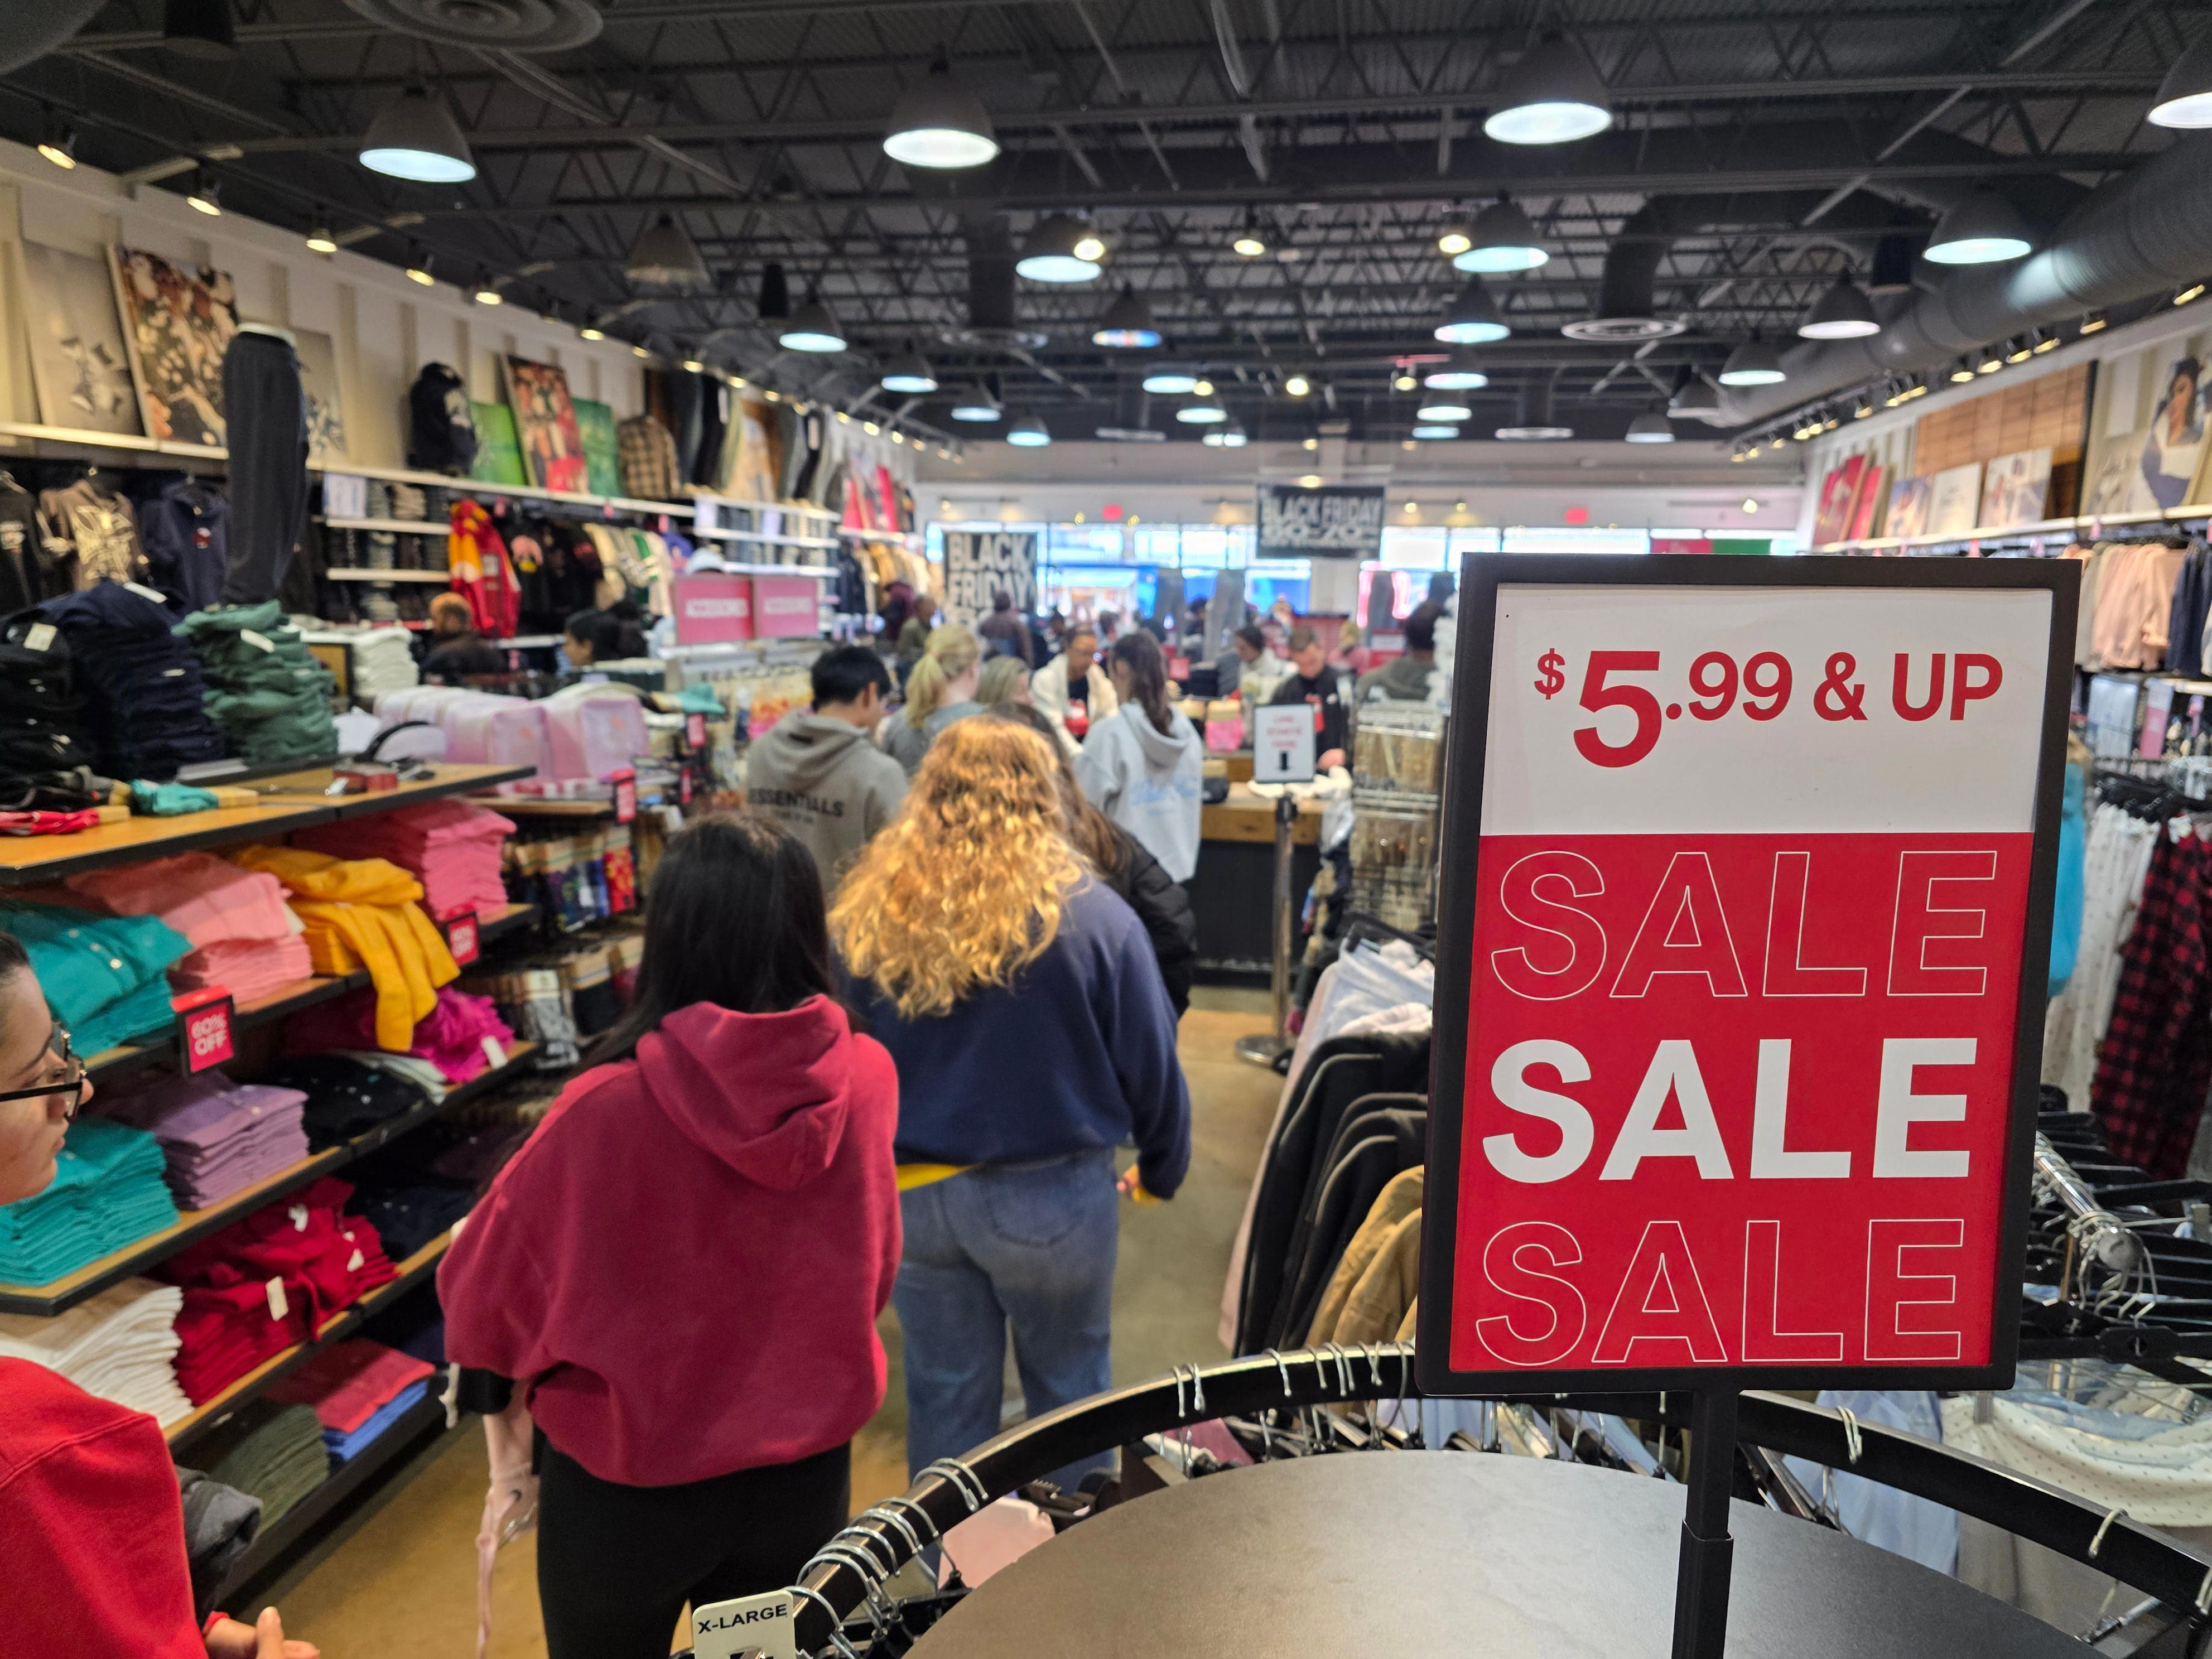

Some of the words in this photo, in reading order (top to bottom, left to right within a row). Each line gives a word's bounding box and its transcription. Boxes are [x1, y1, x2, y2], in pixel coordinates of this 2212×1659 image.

[948, 533, 1031, 571] BLACK
[1534, 648, 1792, 768] $5.99
[1814, 652, 1868, 721] &
[1892, 653, 2003, 721] UP
[1491, 850, 1998, 1001] SALE
[194, 1029, 227, 1055] OFF
[1482, 1037, 1978, 1184] SALE
[1475, 1218, 1965, 1367] SALE
[697, 1603, 788, 1634] X-LARGE
